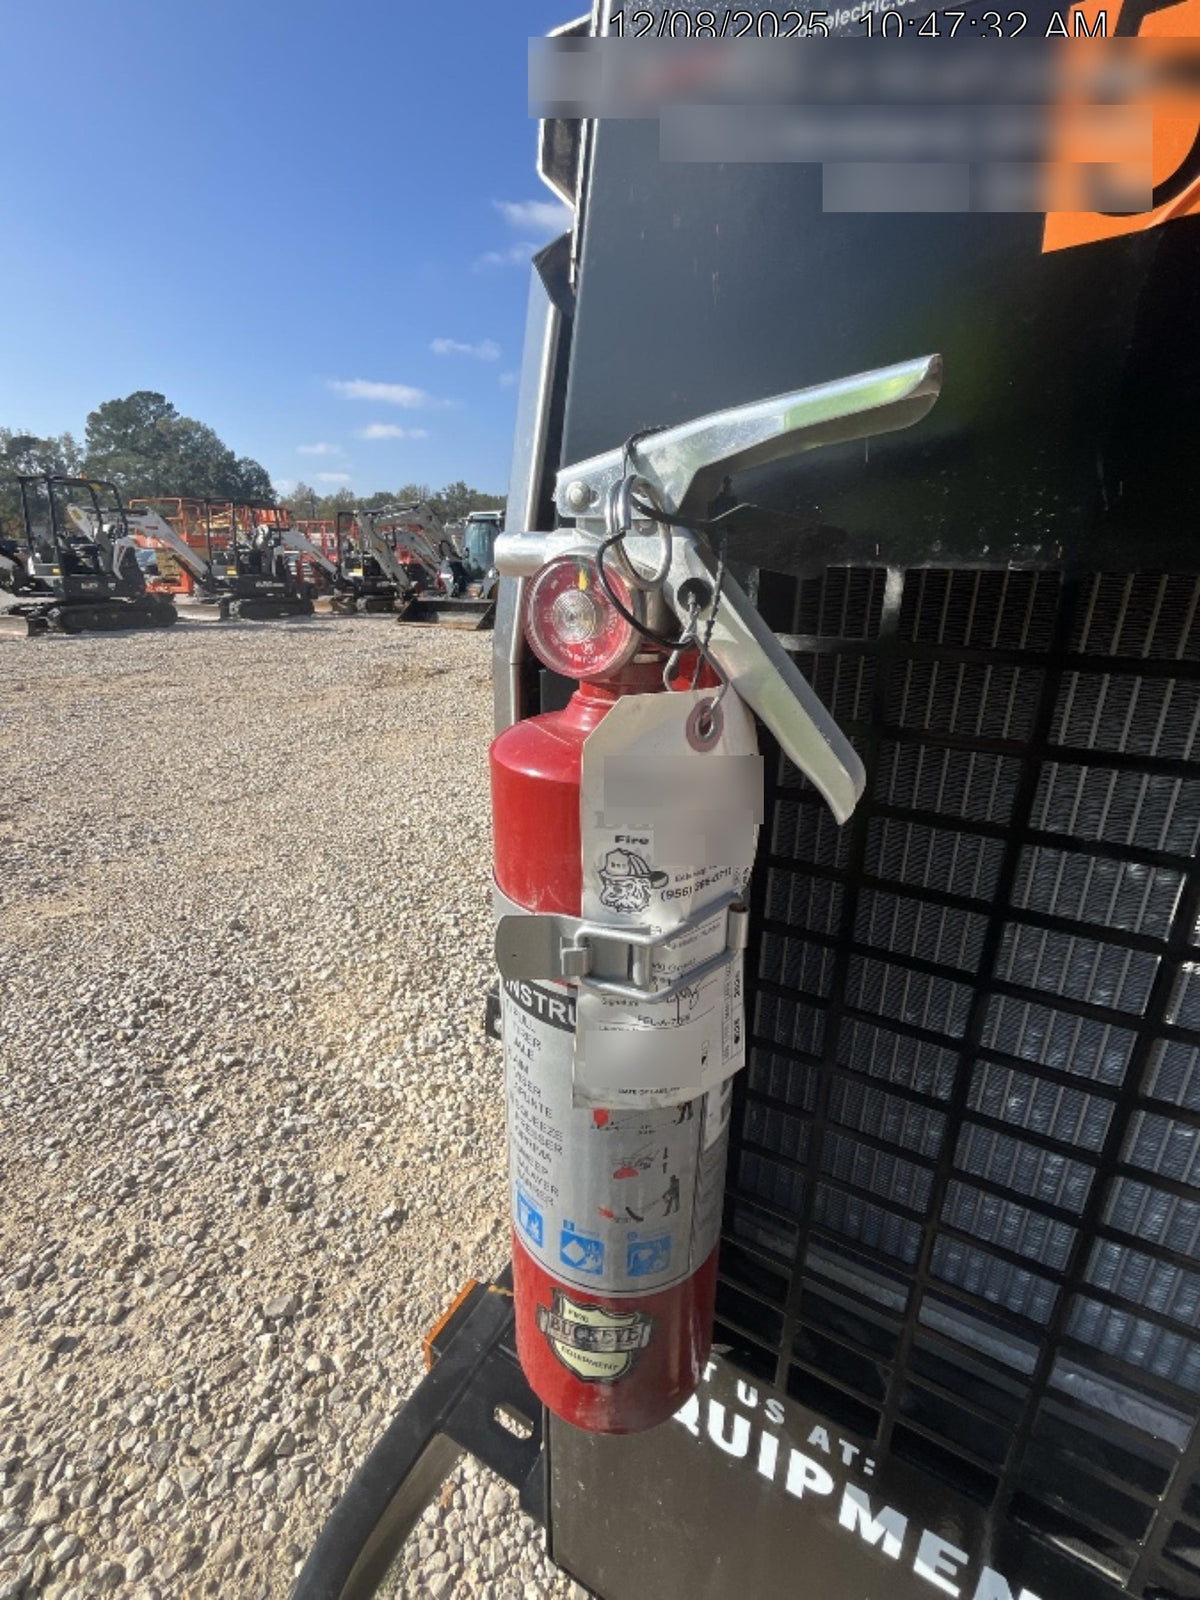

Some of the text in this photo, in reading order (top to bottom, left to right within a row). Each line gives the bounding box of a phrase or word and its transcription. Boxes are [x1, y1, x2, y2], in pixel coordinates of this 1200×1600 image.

[614, 834, 650, 845] Fire
[549, 1316, 641, 1344] BUCKEYE
[736, 1379, 876, 1477] US AT:
